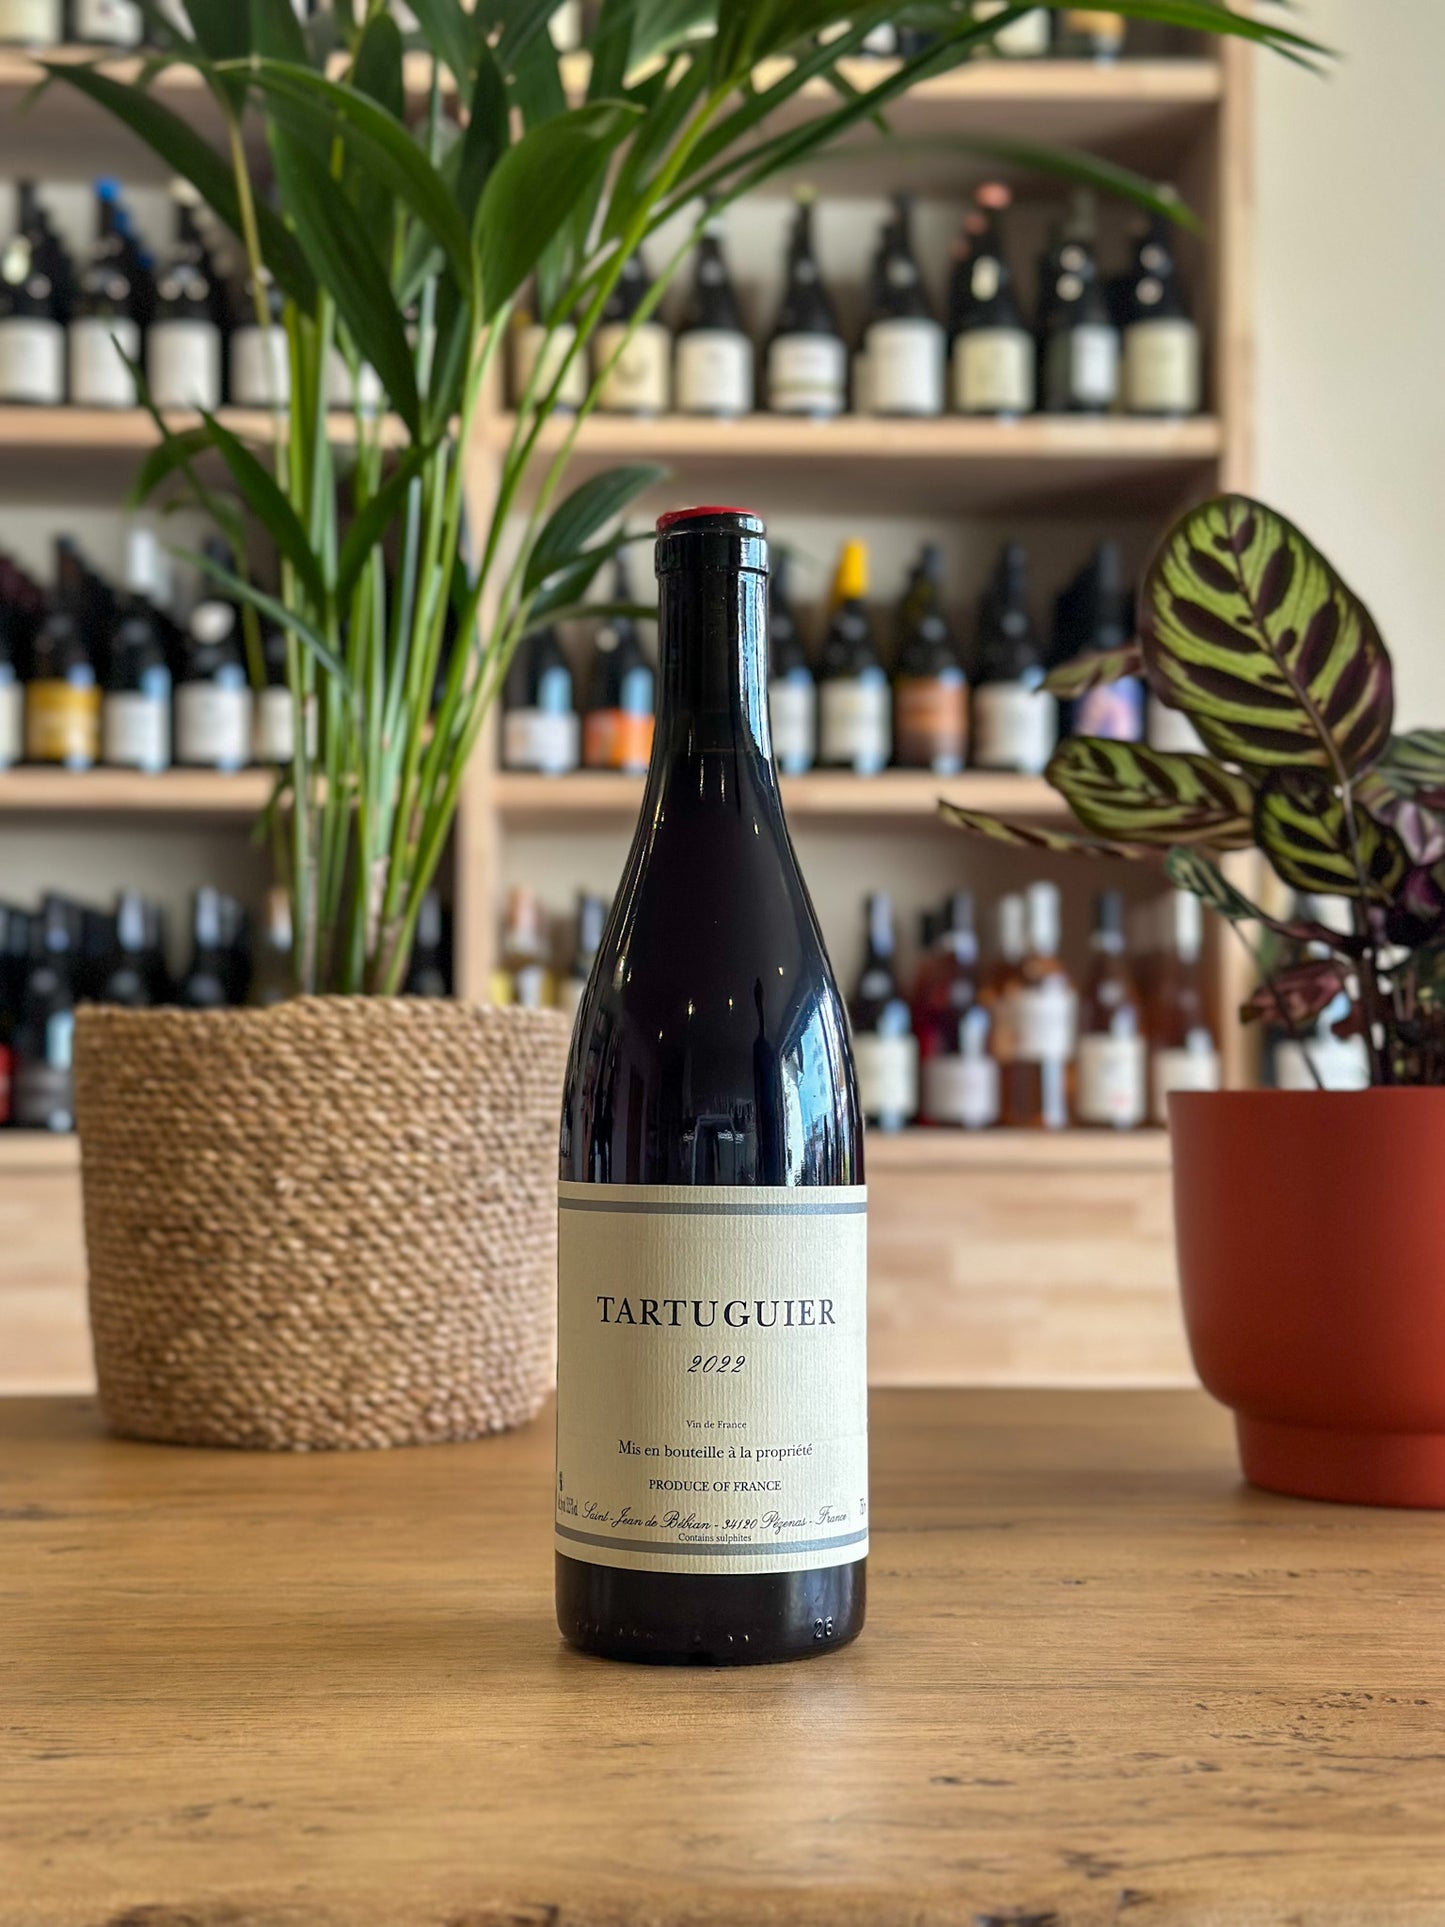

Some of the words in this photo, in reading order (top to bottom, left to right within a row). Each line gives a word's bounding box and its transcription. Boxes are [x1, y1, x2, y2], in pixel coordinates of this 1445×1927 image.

[597, 1296, 836, 1328] TARTUGUIER
[687, 1355, 746, 1373] 2022
[686, 1420, 701, 1429] Vin
[704, 1420, 715, 1429] de
[717, 1420, 747, 1429] France
[618, 1439, 641, 1456] Mis
[644, 1446, 660, 1457] en
[664, 1445, 724, 1459] bouteille
[728, 1445, 737, 1458] à
[740, 1446, 752, 1458] la
[756, 1443, 813, 1462] propriété
[649, 1479, 709, 1492] PRODUCE
[713, 1481, 730, 1492] OF
[733, 1480, 782, 1492] FRANCE
[645, 1514, 658, 1528] de
[660, 1510, 711, 1530] Bébian
[721, 1518, 758, 1530] 34120
[759, 1510, 807, 1535] Pézenas
[815, 1505, 847, 1525] France
[678, 1532, 714, 1542] Contains
[716, 1532, 752, 1544] sulphites
[813, 1615, 833, 1639] 26
